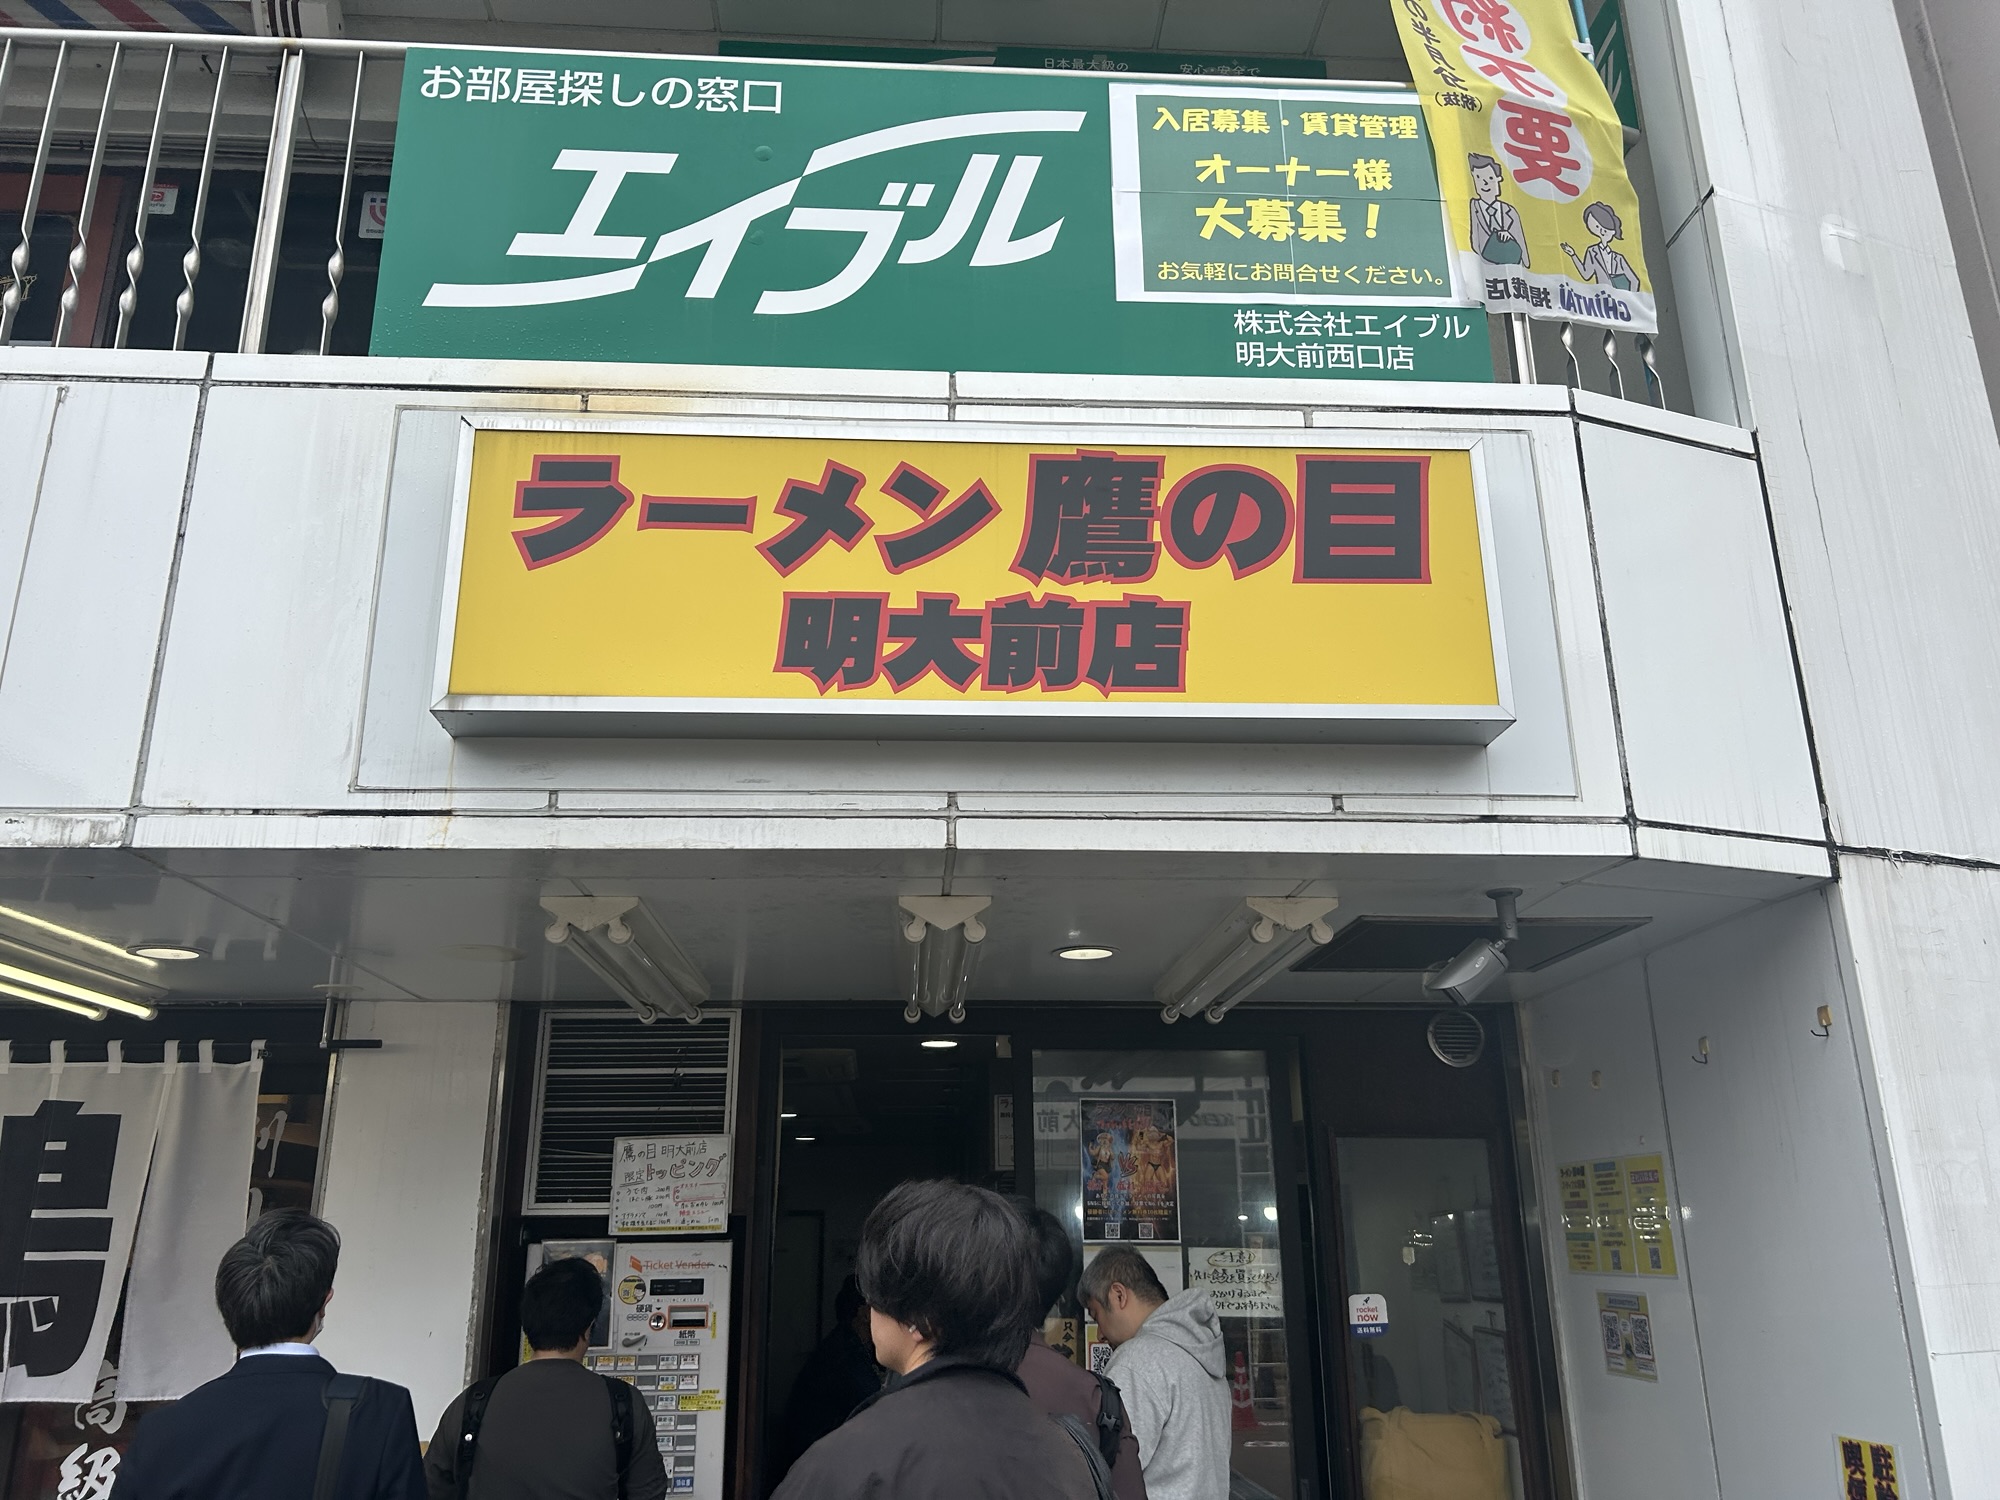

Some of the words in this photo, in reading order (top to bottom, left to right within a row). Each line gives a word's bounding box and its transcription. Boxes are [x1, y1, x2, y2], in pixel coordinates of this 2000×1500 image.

[1044, 58, 1129, 71] 日本最大級の
[420, 64, 783, 115] お部屋探しの窓口
[1153, 107, 1418, 139] 入居募集・賃貸管理
[1195, 154, 1393, 191] オーナー様
[422, 110, 1087, 314] エイブル
[1195, 197, 1380, 243] 大募集！
[1158, 261, 1443, 286] お気軽にお問合せください。
[1233, 308, 1471, 340] 株式会社エイブル
[1236, 342, 1414, 371] 明大前西口店
[773, 592, 1190, 697] 明大前店
[619, 1143, 656, 1163] 鷹の目
[661, 1141, 707, 1158] 明大前店
[646, 1153, 727, 1181] トッピング
[1118, 1151, 1138, 1178] VS
[644, 1260, 673, 1270] Ticket
[676, 1260, 711, 1270] Vender
